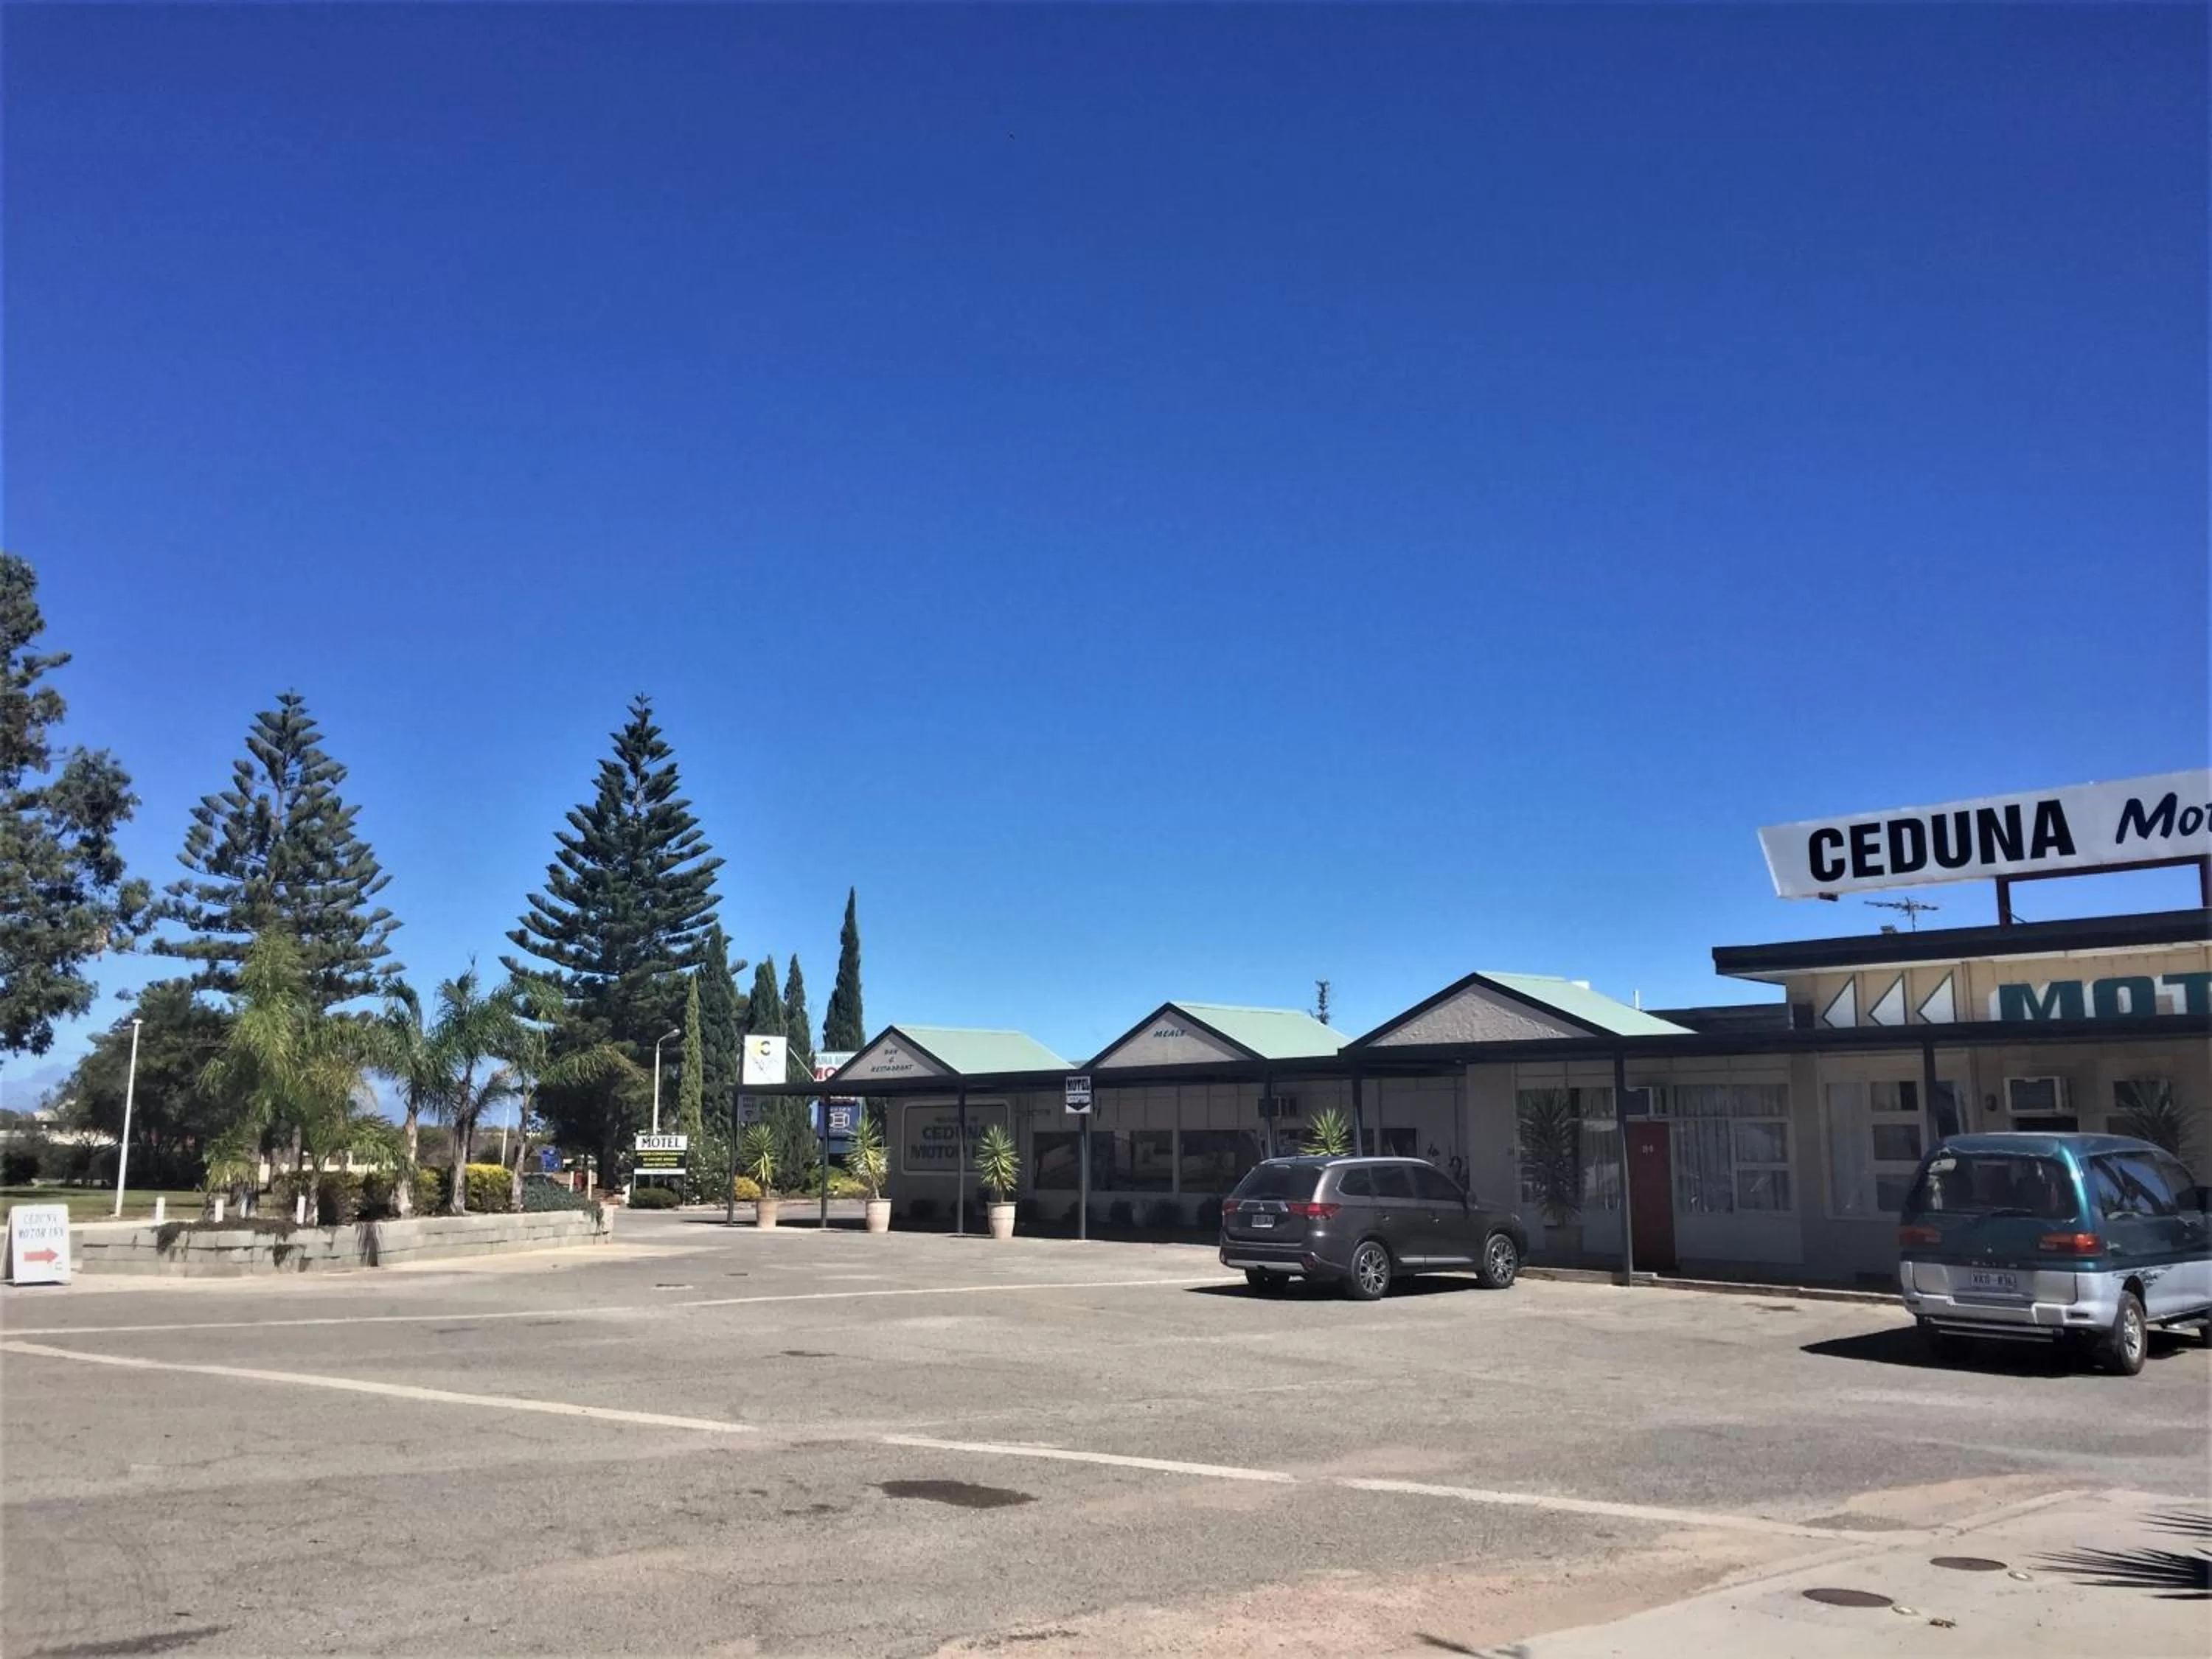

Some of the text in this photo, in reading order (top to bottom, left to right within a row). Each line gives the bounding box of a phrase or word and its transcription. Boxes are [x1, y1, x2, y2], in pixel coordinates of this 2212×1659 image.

[1809, 799, 2076, 883] CEDUNA
[1989, 972, 2212, 1020] MOT
[1067, 1078, 1090, 1091] MOTEL
[640, 1137, 681, 1148] MOTEL
